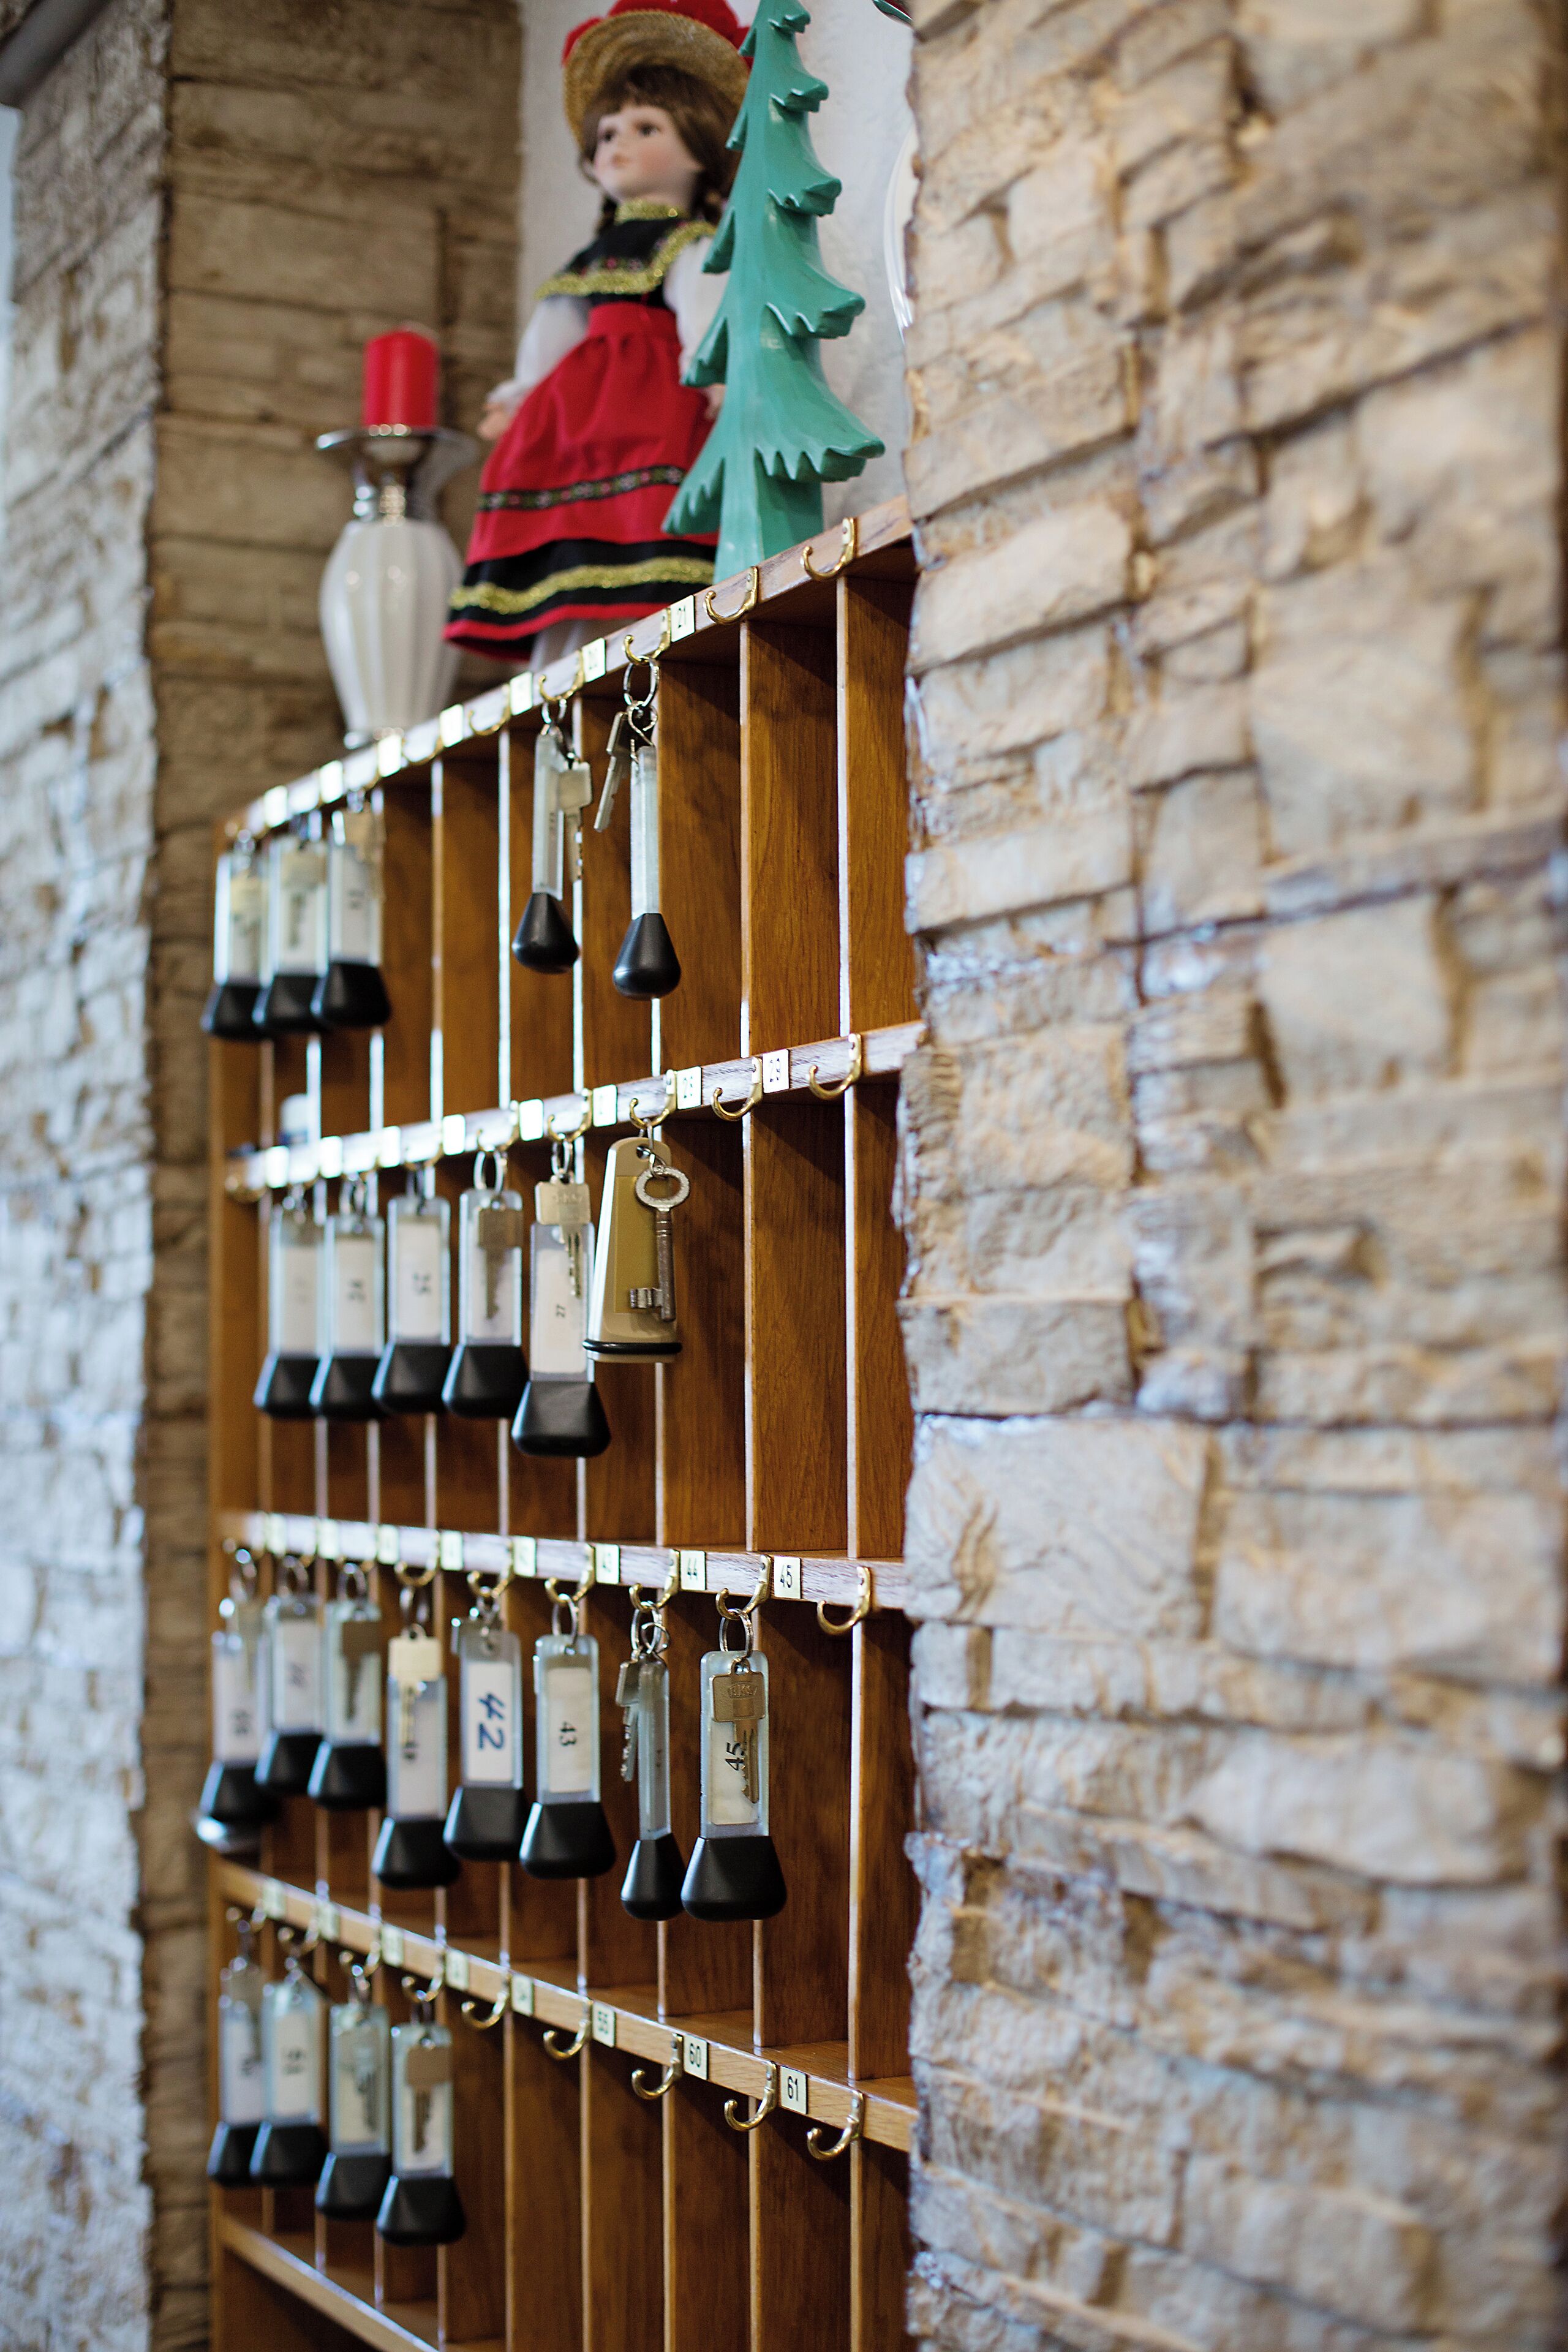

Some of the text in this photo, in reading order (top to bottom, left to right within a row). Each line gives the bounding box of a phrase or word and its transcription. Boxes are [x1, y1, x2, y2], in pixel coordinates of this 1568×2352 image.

[769, 1058, 781, 1083] 29
[687, 1558, 698, 1581] 44
[780, 1564, 793, 1589] 45
[478, 1692, 505, 1751] 42
[559, 1720, 578, 1747] 43
[725, 1742, 745, 1771] 45
[690, 2042, 701, 2068] 60
[788, 2075, 799, 2102] 61
